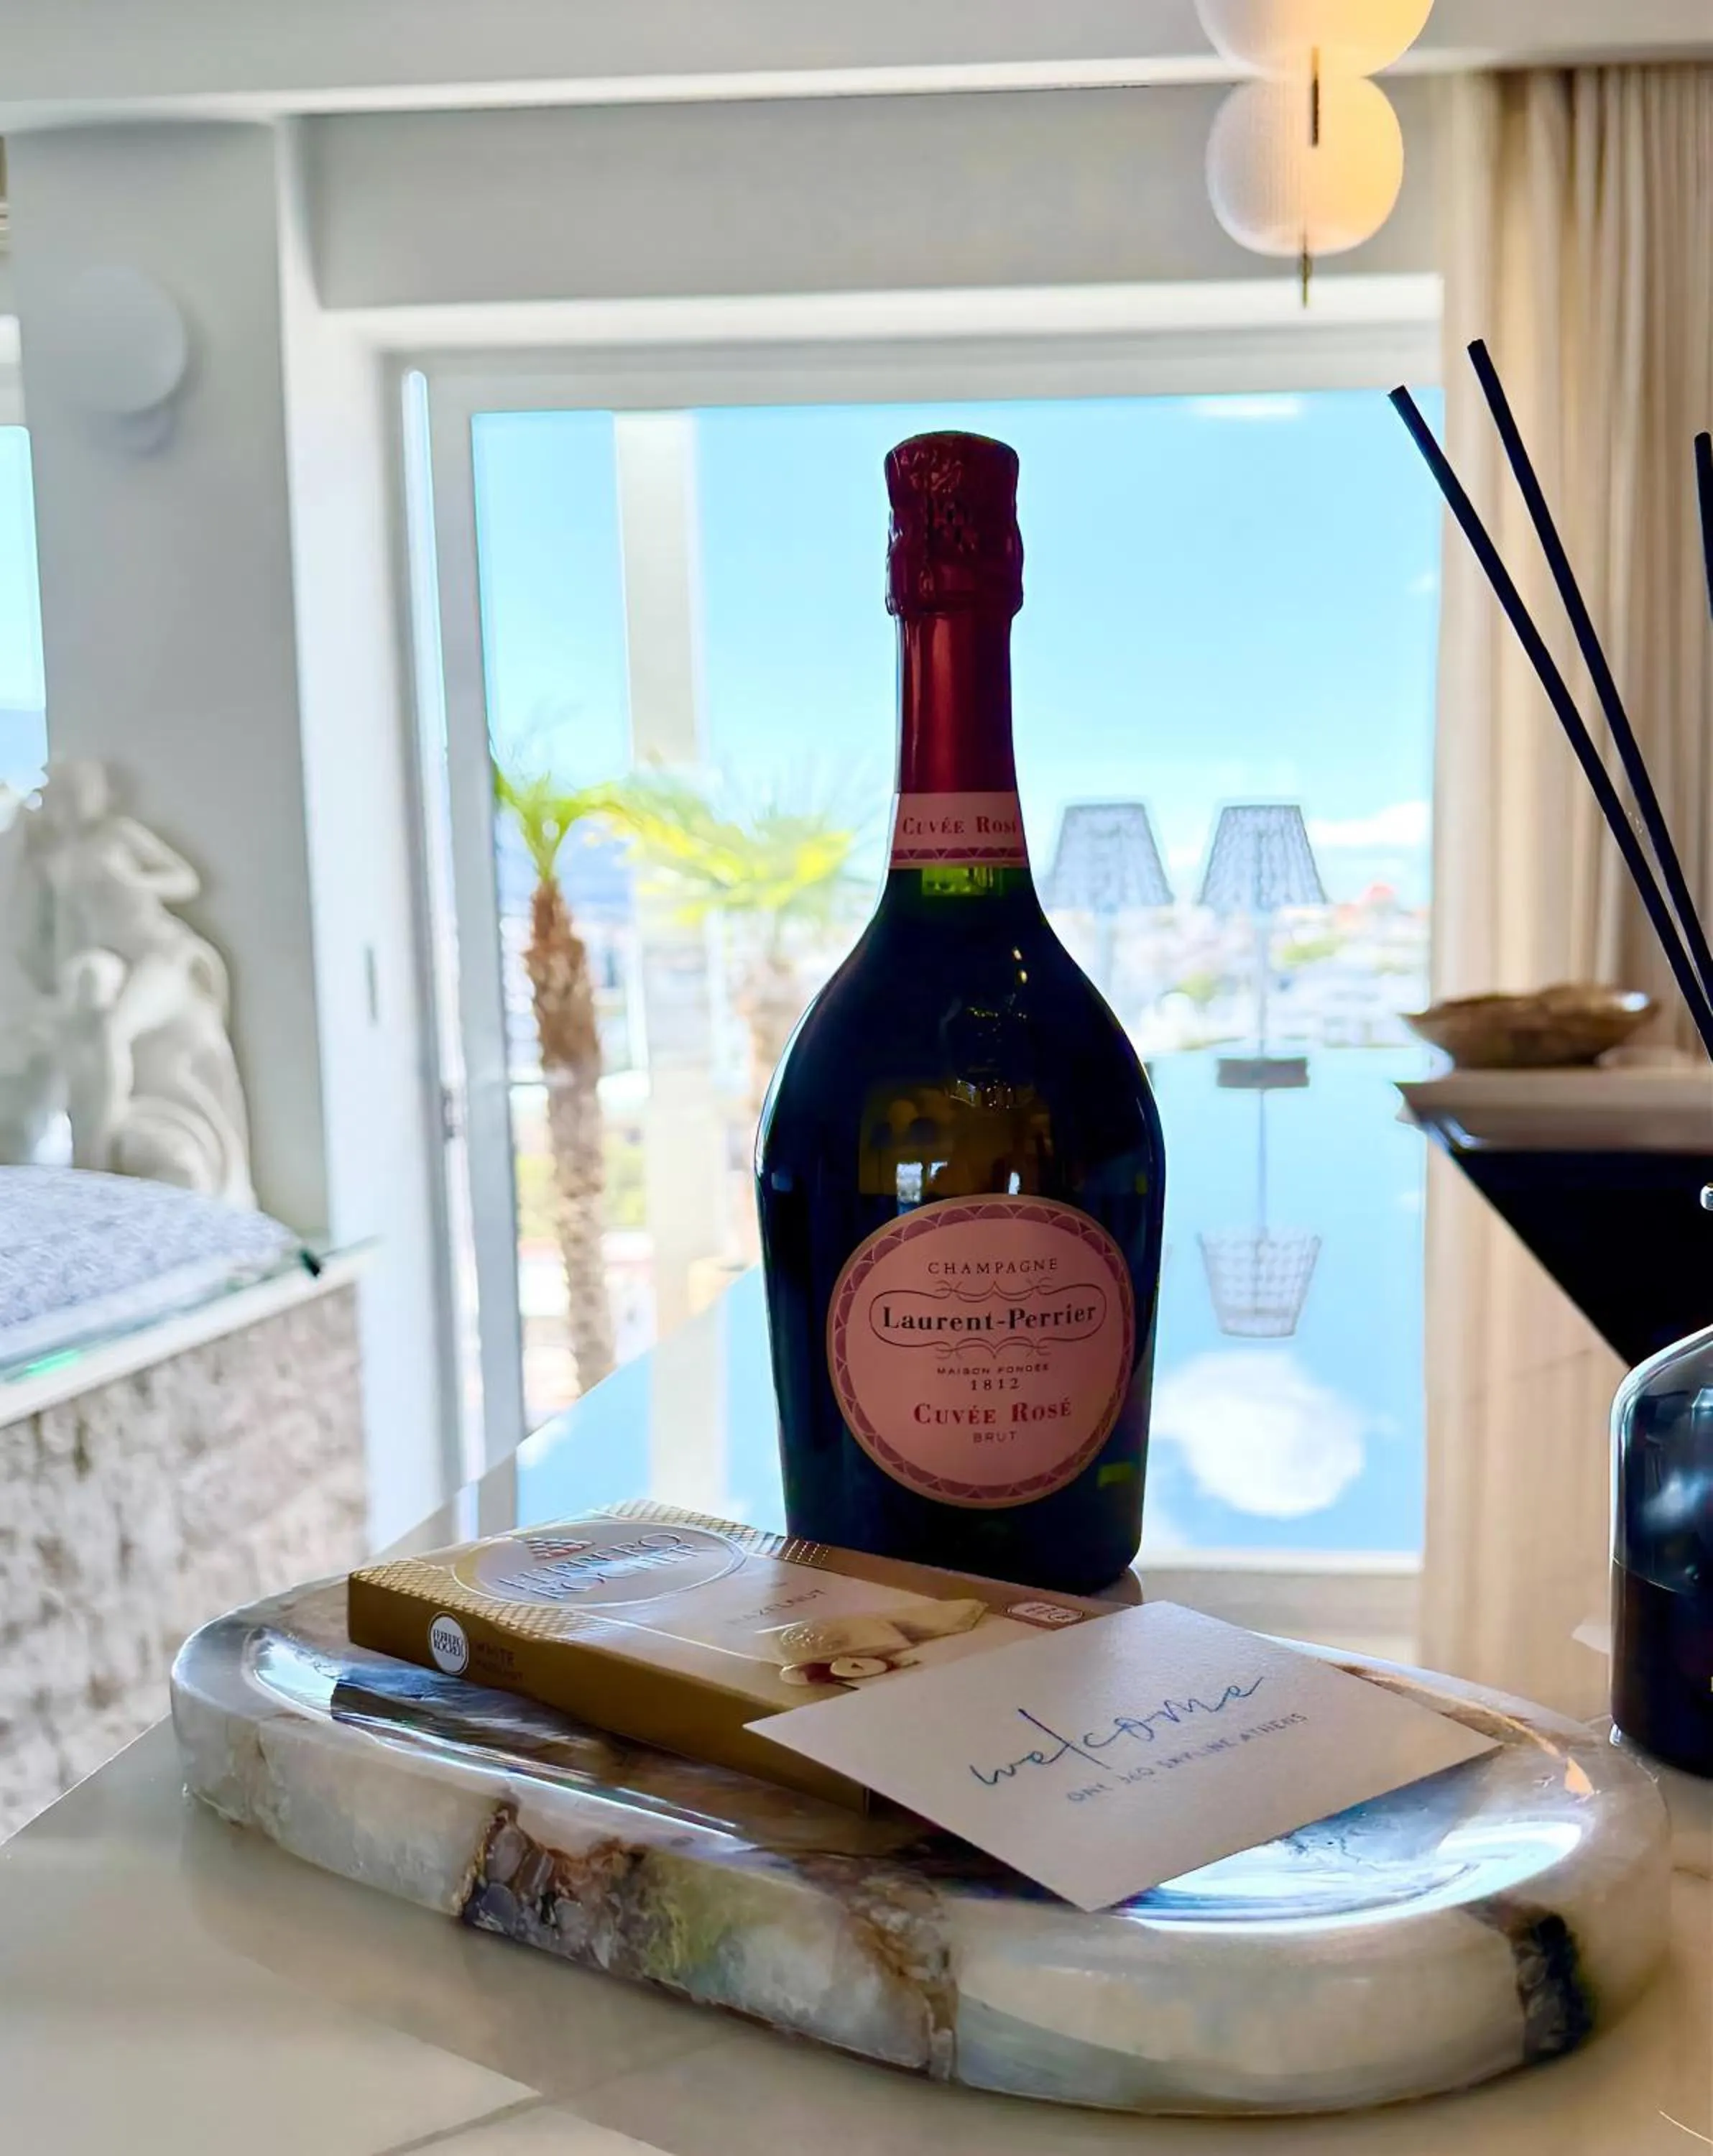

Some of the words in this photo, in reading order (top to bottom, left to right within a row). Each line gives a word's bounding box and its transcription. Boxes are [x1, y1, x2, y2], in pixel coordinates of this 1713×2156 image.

[902, 816, 965, 835] CUVÉE
[928, 1258, 1059, 1275] CHAMPAGNE
[882, 1303, 1096, 1331] Laurent-Perrier
[936, 1366, 990, 1376] MAISON
[971, 1378, 1020, 1391] 1812
[913, 1402, 997, 1425] CUVÉE
[1011, 1397, 1071, 1423] ROSÉ
[972, 1430, 1017, 1444] BRUT
[970, 1676, 1265, 1784] welcome
